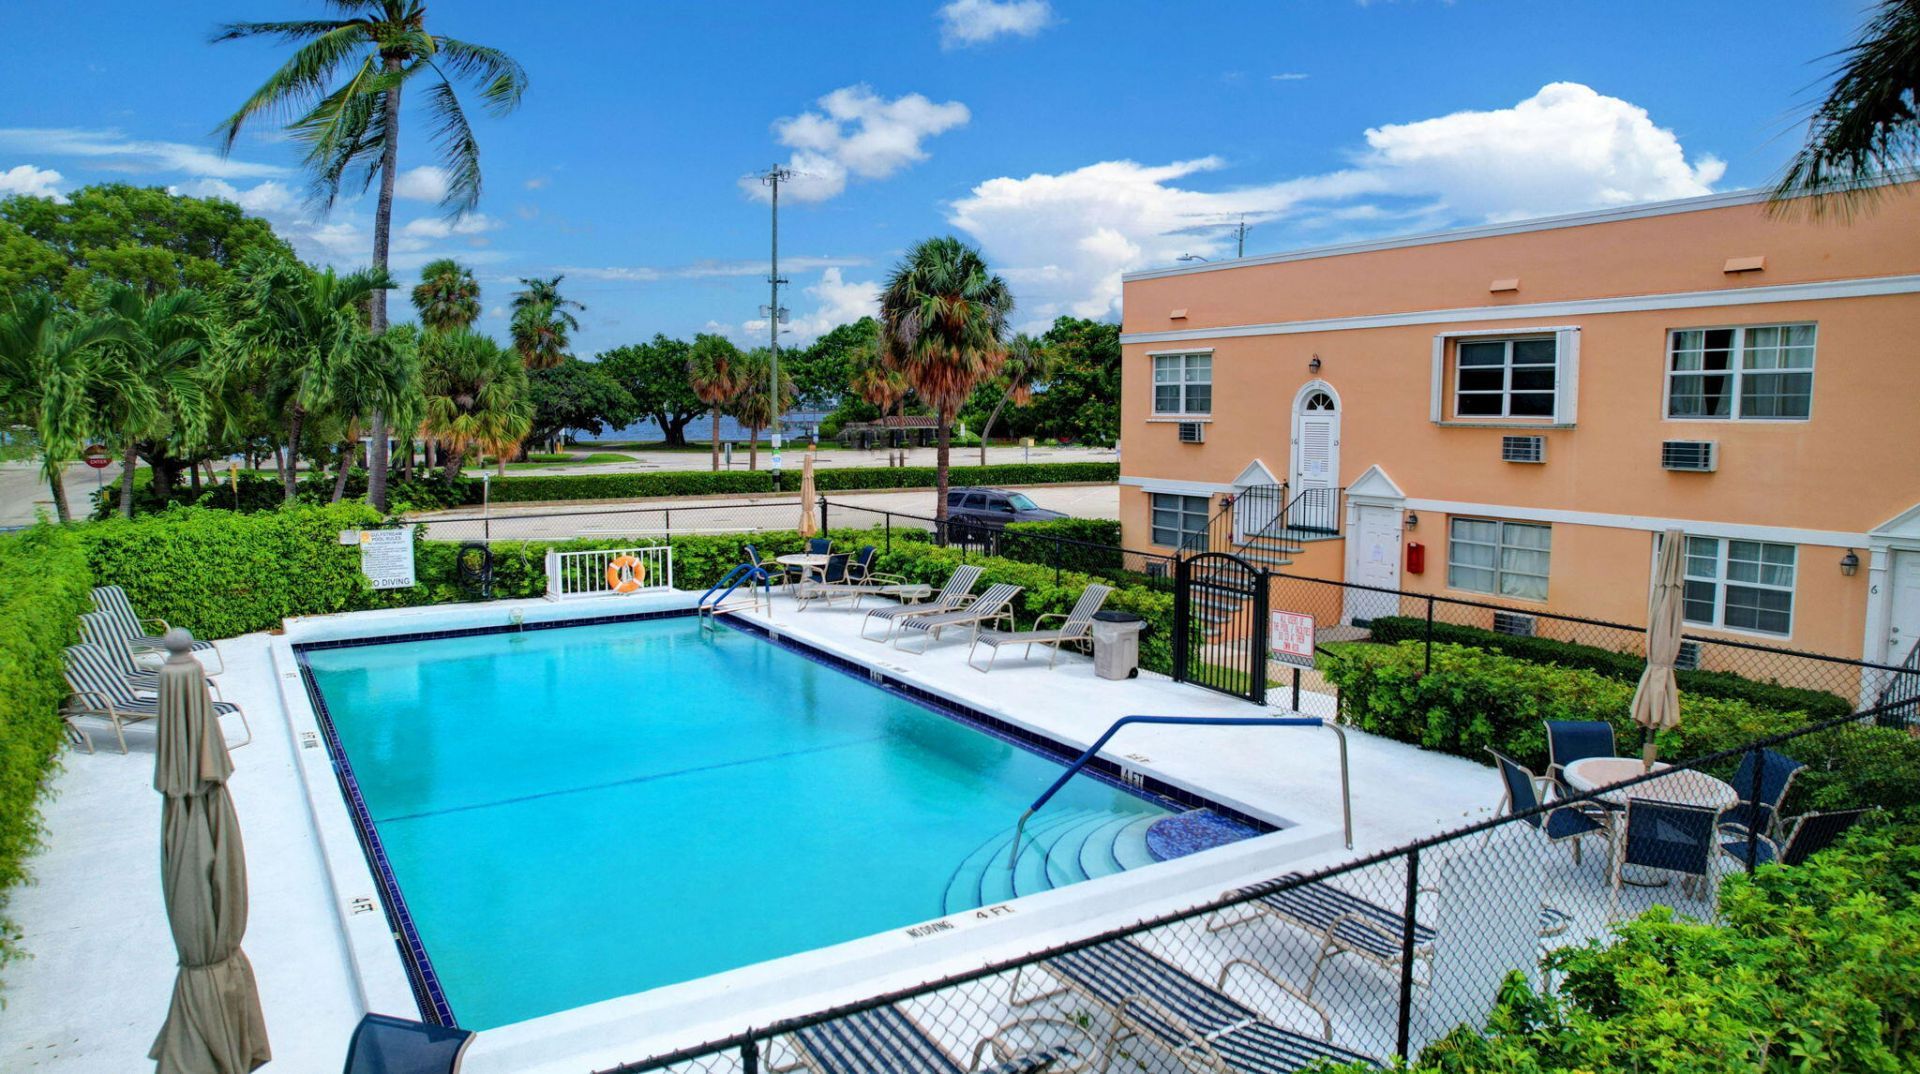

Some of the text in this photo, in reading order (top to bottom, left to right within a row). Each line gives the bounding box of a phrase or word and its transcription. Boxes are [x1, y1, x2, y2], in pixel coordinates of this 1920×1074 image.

[382, 577, 410, 586] DIVING
[1870, 585, 1878, 595] 6
[1132, 771, 1143, 787] FT
[975, 904, 1016, 919] 4 FT
